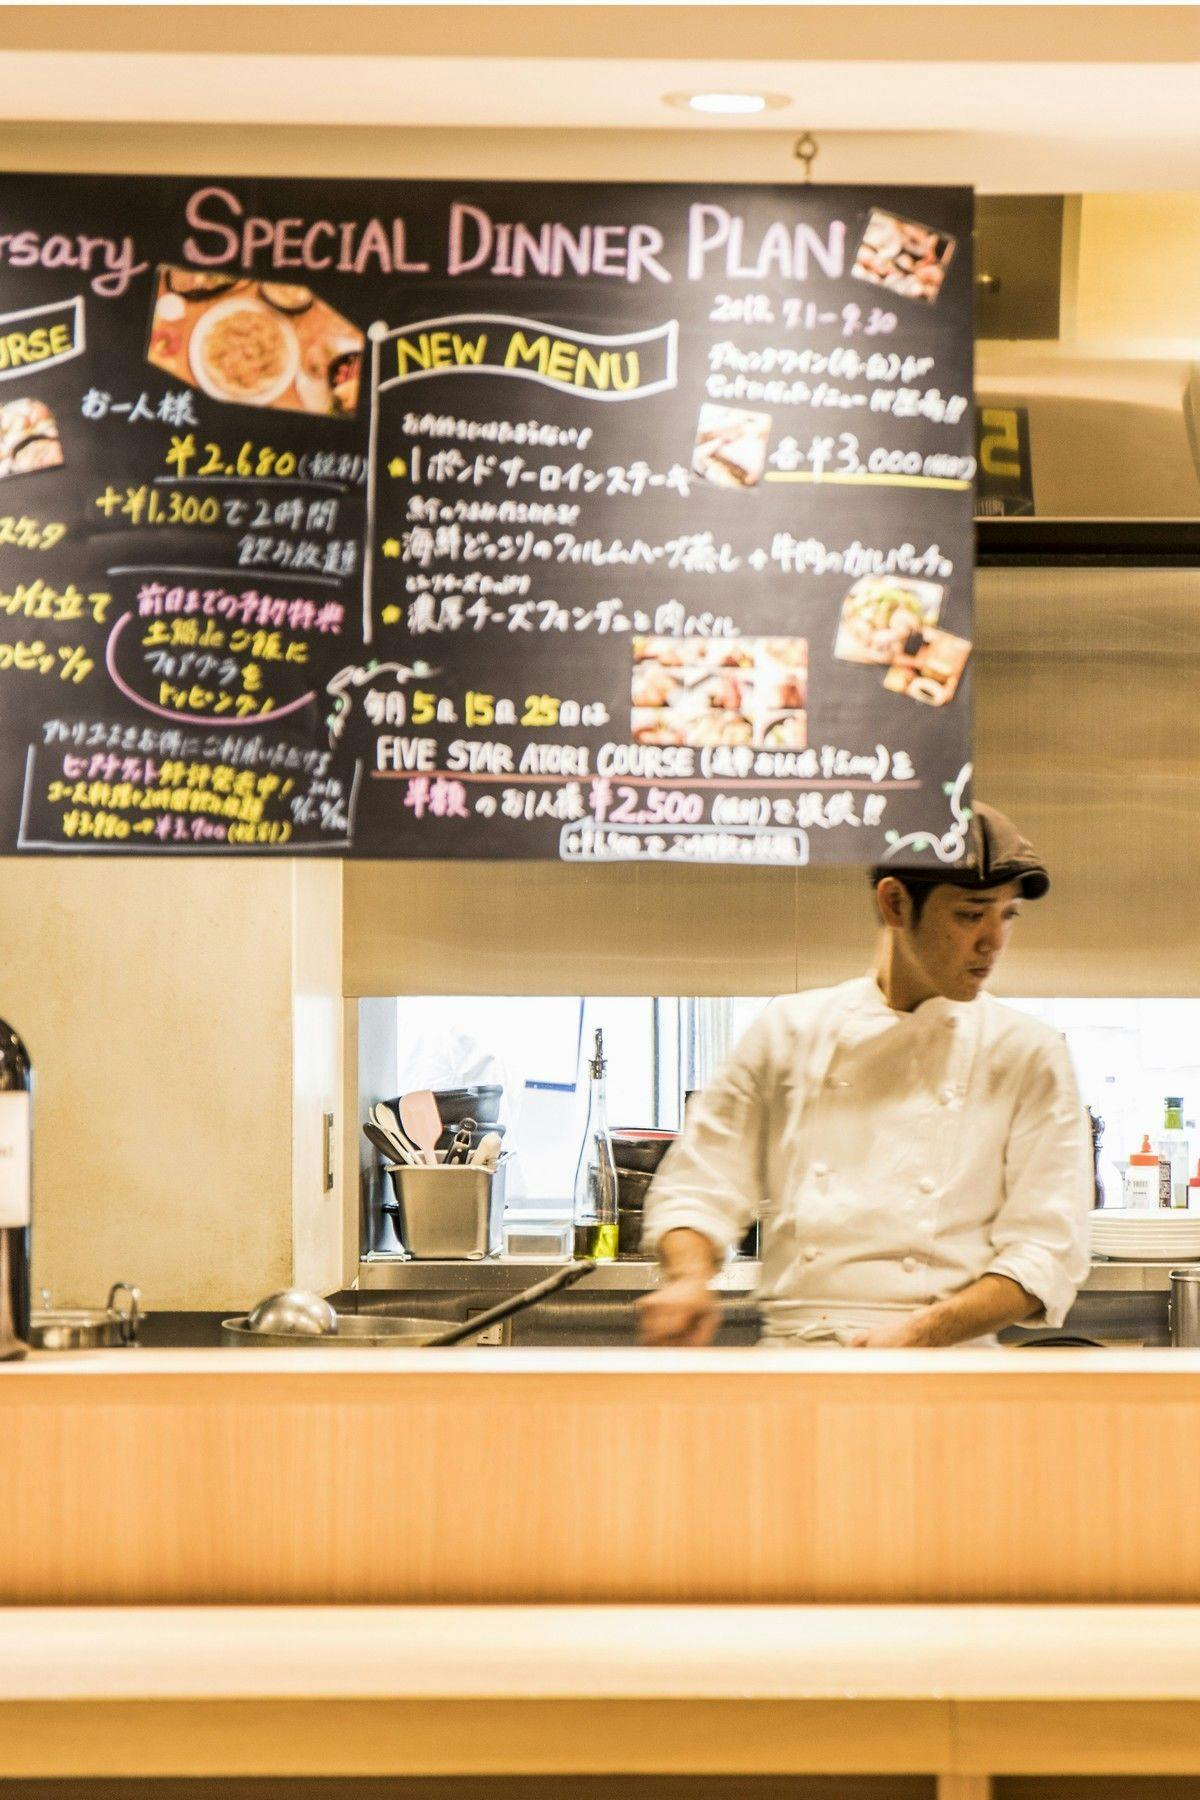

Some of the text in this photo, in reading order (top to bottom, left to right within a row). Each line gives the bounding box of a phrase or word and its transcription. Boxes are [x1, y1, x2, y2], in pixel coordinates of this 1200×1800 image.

[397, 331, 641, 391] NEW MENU
[376, 734, 437, 772] FIVE
[446, 738, 516, 775] STAR
[596, 742, 695, 779] COURSE
